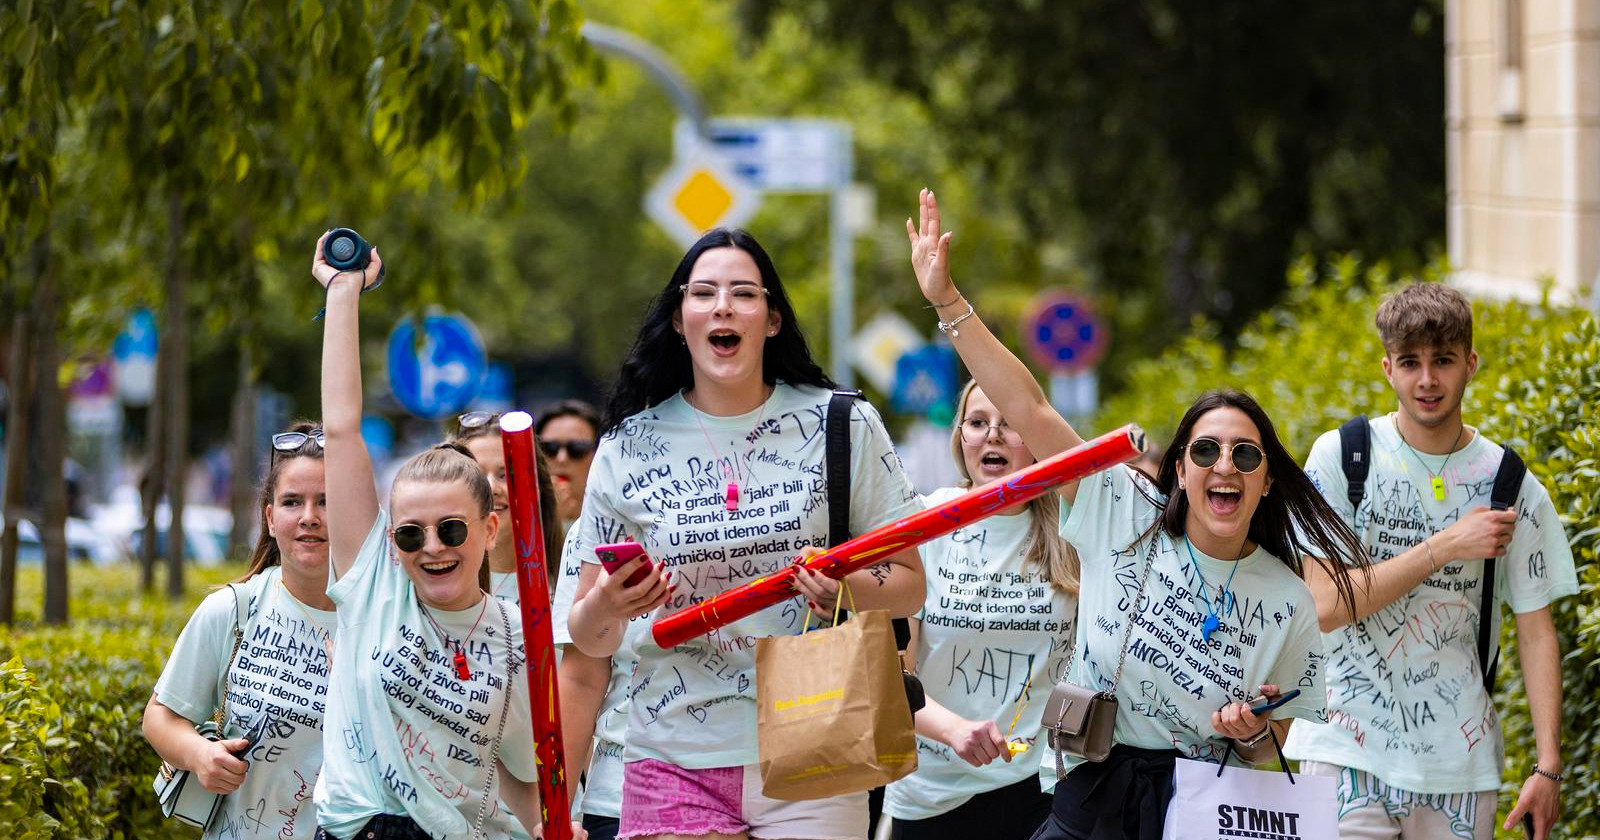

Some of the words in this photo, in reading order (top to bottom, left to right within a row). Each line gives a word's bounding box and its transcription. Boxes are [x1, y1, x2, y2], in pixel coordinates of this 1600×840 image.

[661, 499, 680, 510] Na
[685, 493, 728, 512] gradiv
[783, 480, 803, 495] bili
[677, 510, 724, 526] Branki
[770, 500, 790, 517] pili
[1371, 510, 1386, 526] Na
[669, 532, 680, 547] U
[685, 528, 720, 545] život
[724, 523, 770, 540] idemo
[775, 516, 801, 533] sad
[1378, 532, 1416, 547] Branki
[663, 550, 726, 568] obrtničkoj
[730, 540, 790, 559] zavladat
[794, 536, 810, 550] će
[1369, 545, 1378, 557] U
[1443, 565, 1463, 575] sad
[938, 567, 954, 580] Na
[958, 572, 1002, 584] gradivu
[1462, 579, 1479, 594] jad
[940, 597, 950, 609] U
[953, 599, 983, 613] život
[986, 604, 1026, 614] idemo
[1029, 602, 1052, 614] sad
[949, 584, 989, 598] Branki
[991, 585, 1023, 599] živce
[1027, 586, 1045, 600] pili
[926, 612, 985, 632] obrtničkoj
[988, 619, 1041, 632] zavladat
[1044, 619, 1058, 632] će
[1163, 595, 1202, 628] Branki
[252, 624, 328, 665] MILANA
[1117, 597, 1130, 612] U
[1129, 612, 1185, 659] obrtničkoj
[1185, 654, 1230, 693] zavladat
[1232, 684, 1245, 701] će
[1152, 602, 1164, 617] U
[1163, 614, 1189, 643] život
[1222, 662, 1244, 681] sad
[1239, 632, 1257, 649] bili
[240, 641, 249, 651] a
[250, 646, 298, 667] gradivu
[302, 658, 329, 677] “jaki
[399, 625, 415, 642] Na
[415, 635, 452, 668] gradivu
[487, 674, 502, 691] bili
[1127, 637, 1207, 701] ANTONELA
[1357, 622, 1393, 693] PETRA
[238, 656, 279, 678] Branki
[280, 669, 313, 690] živce
[315, 684, 329, 696] pi
[383, 652, 395, 668] U
[392, 662, 423, 692] život
[422, 684, 463, 715] idemo
[465, 708, 491, 727] sad
[398, 645, 433, 680] Branki
[433, 671, 467, 696] živce
[469, 689, 490, 705] pili
[239, 674, 267, 692] život
[269, 683, 309, 707] idemo
[312, 701, 326, 713] sa
[380, 674, 416, 708] ničkoj
[416, 702, 470, 738] zavladat
[265, 702, 318, 729] zavladat
[1398, 700, 1436, 733] IVA
[1218, 804, 1299, 836] STMNT
